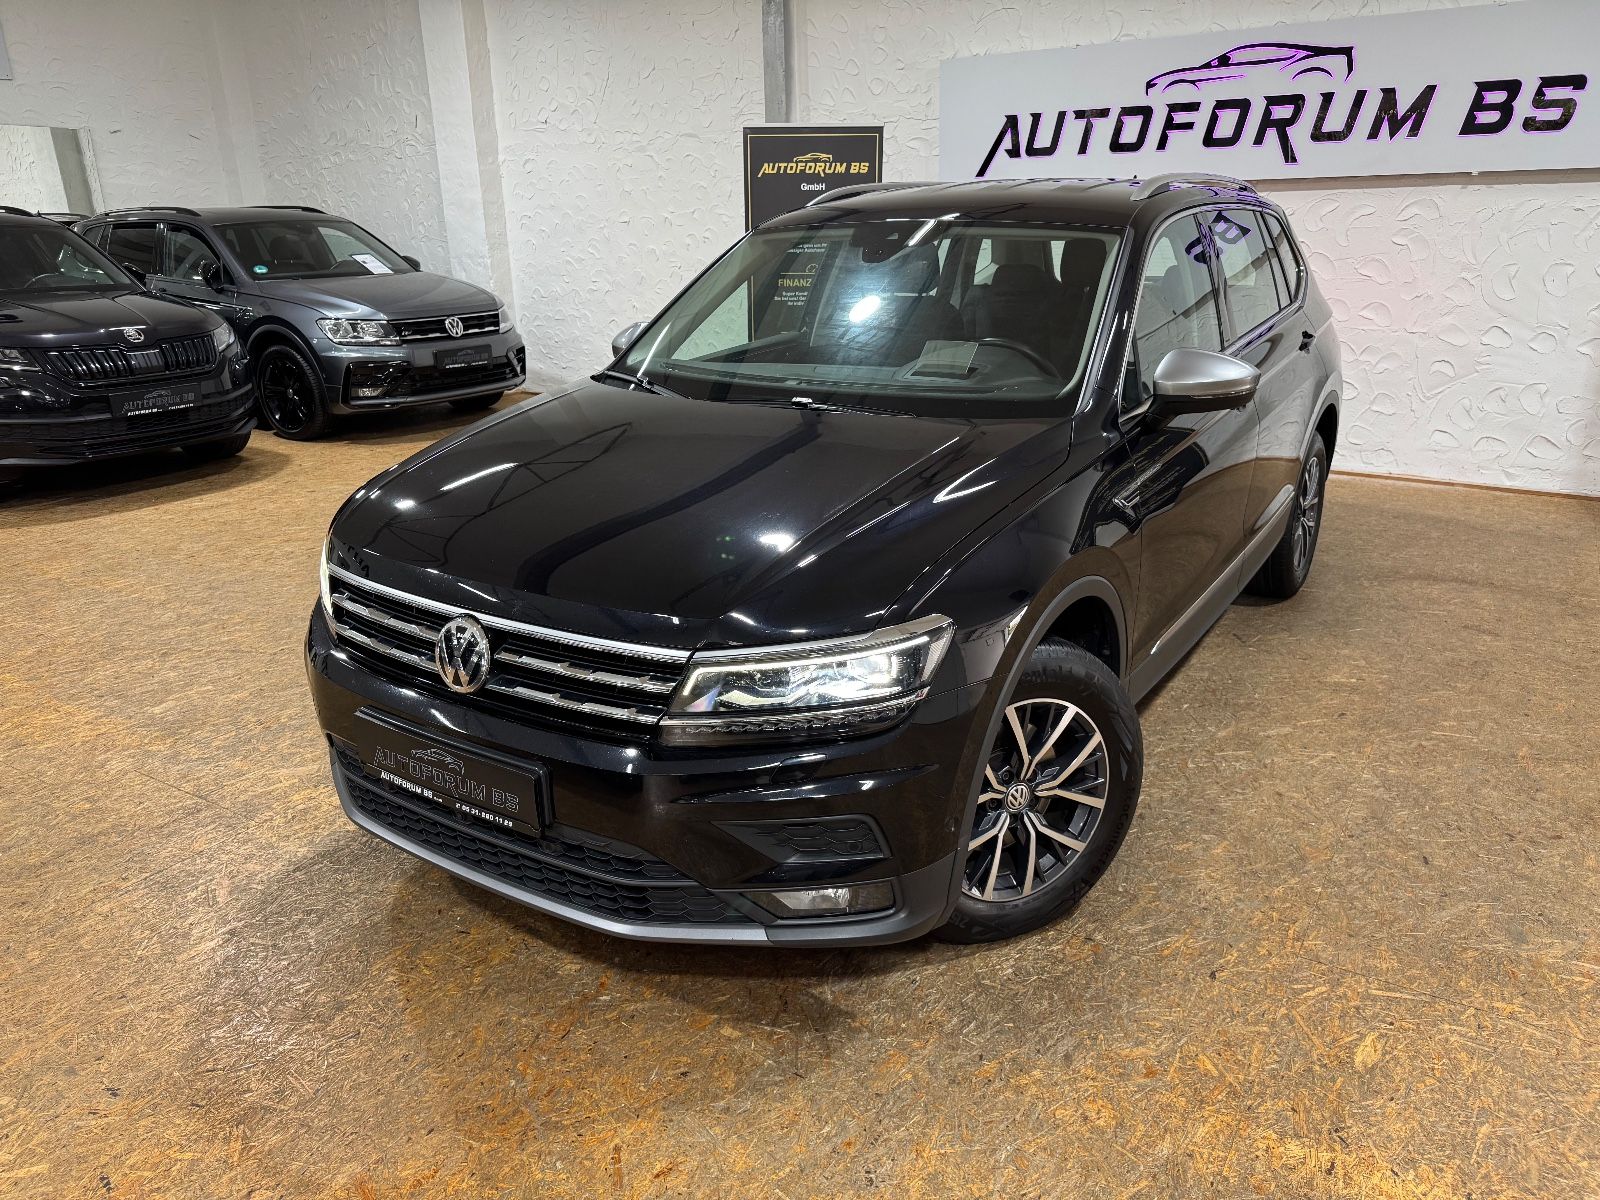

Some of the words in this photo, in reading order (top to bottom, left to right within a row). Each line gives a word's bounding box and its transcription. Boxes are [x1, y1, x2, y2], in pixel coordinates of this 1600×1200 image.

[975, 84, 1439, 178] AUTOFORUM
[1457, 74, 1588, 136] BS
[757, 162, 847, 178] AUTOFORUM
[849, 162, 870, 174] BS
[800, 183, 826, 191] GmbH
[778, 278, 813, 287] FINANZ
[373, 746, 486, 801] AUTOFORUM
[492, 787, 519, 812] BS
[381, 769, 422, 794] AUTOFORUM
